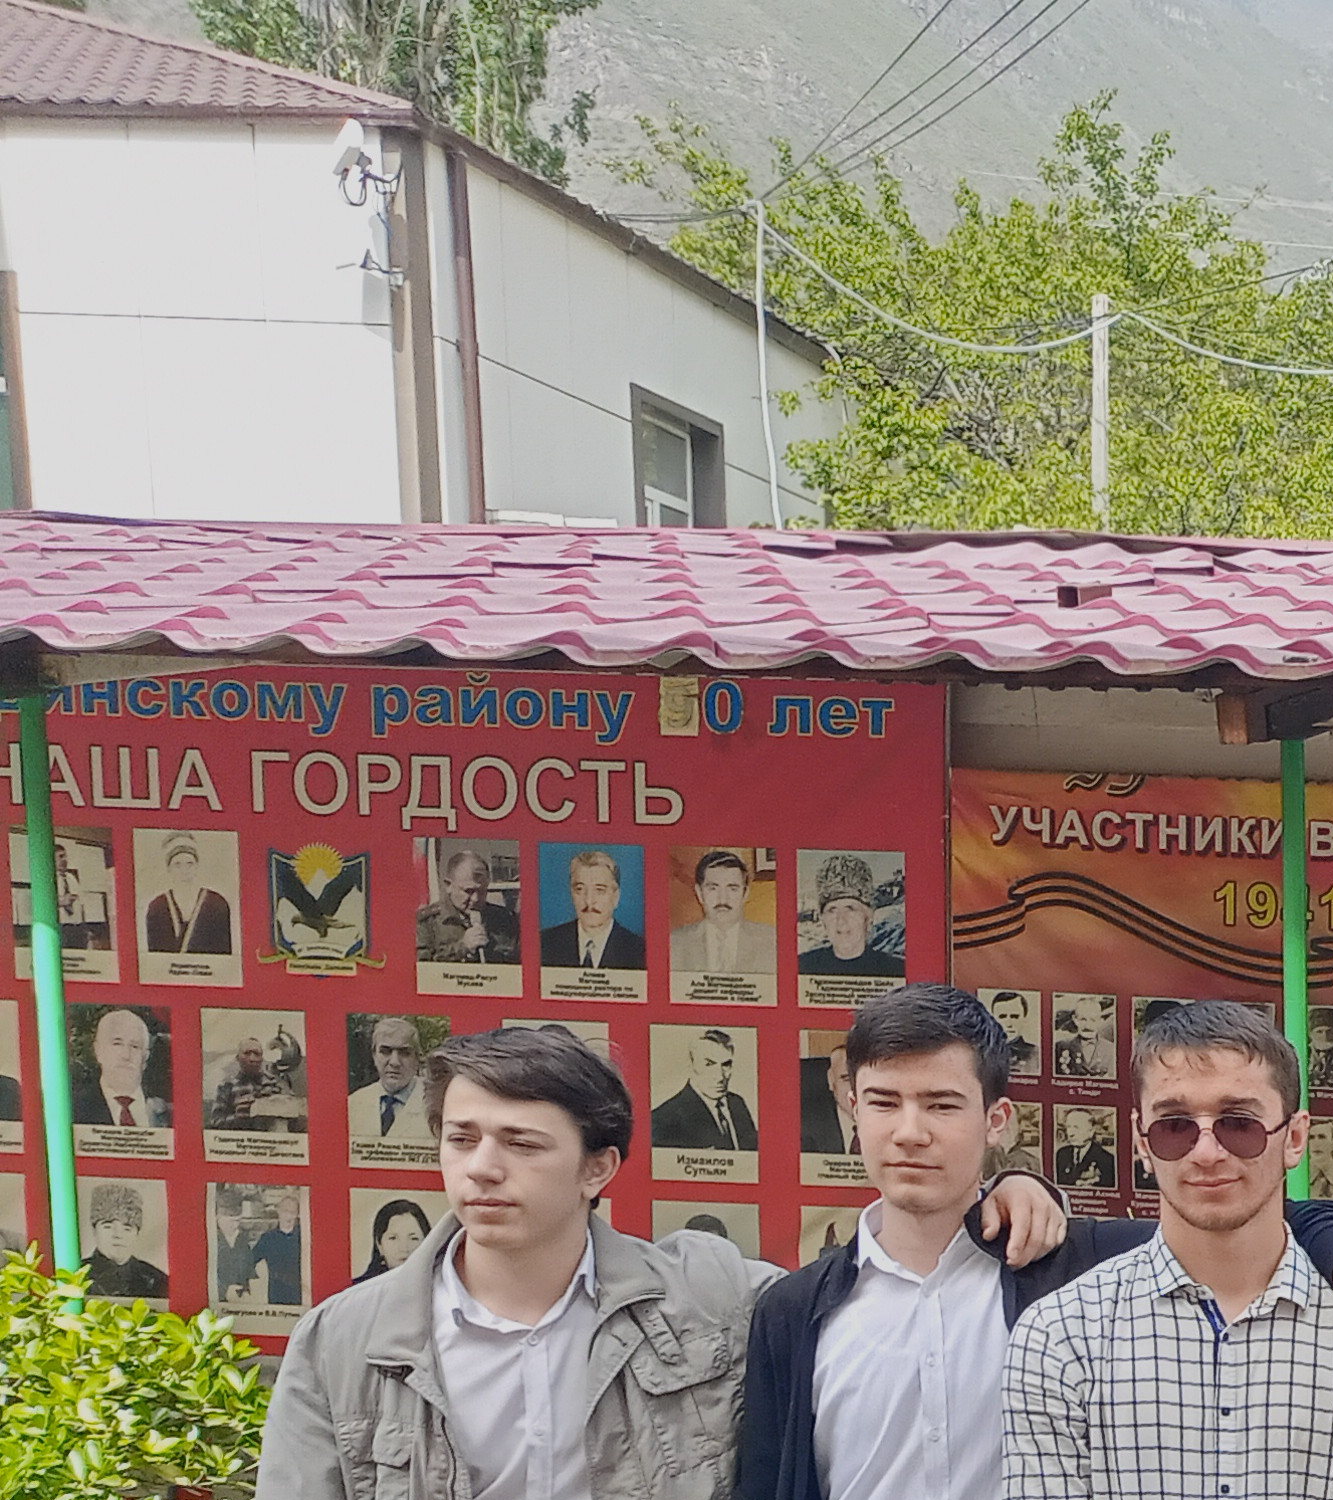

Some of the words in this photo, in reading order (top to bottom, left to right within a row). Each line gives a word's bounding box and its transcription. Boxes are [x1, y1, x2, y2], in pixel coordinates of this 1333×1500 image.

[0, 676, 347, 738] инскому
[370, 671, 636, 746] району
[766, 694, 896, 739] лет
[250, 748, 686, 833] ГОРДОСТЬ
[988, 804, 1284, 860] УЧАСТНИКИ
[676, 1154, 735, 1167] Измаилов
[684, 1165, 728, 1177] Супьян
